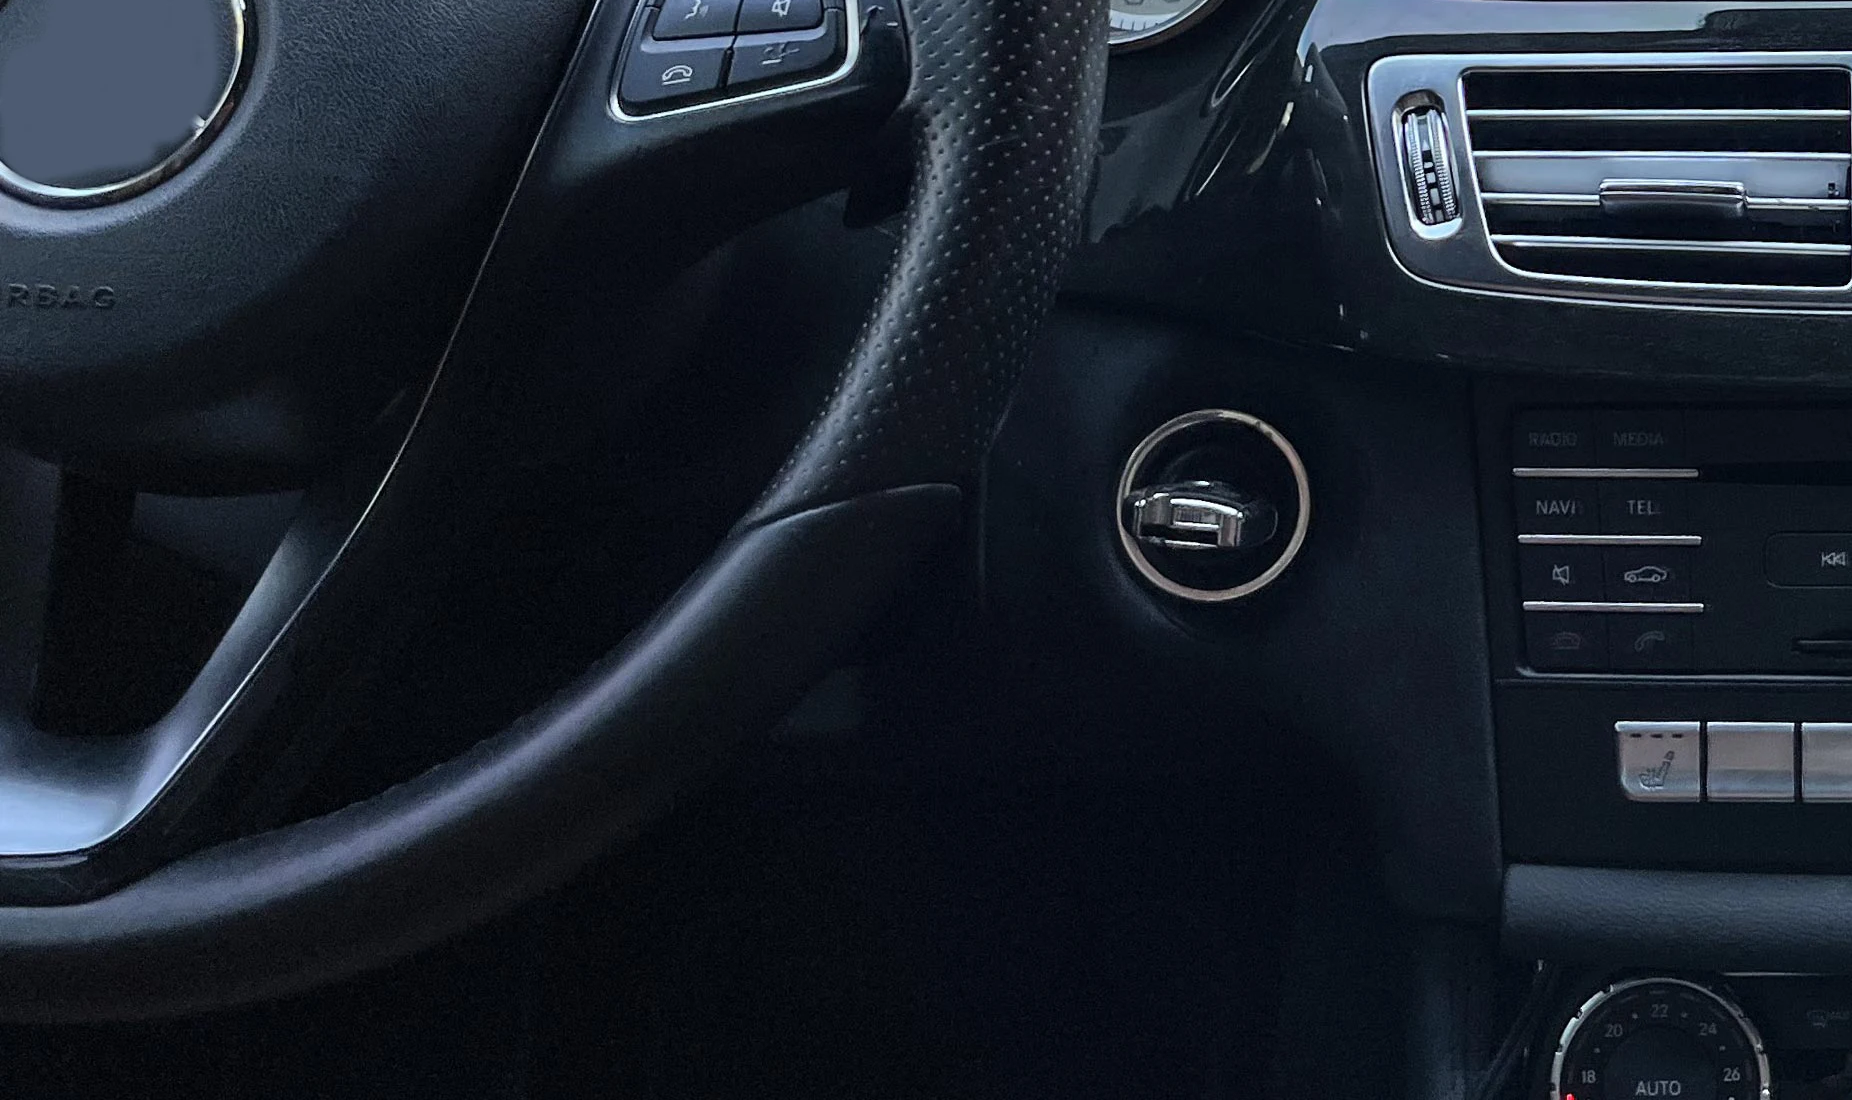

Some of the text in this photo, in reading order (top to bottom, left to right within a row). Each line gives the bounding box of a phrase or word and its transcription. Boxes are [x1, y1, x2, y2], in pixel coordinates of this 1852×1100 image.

[1535, 499, 1576, 515] NAVI
[1651, 1003, 1669, 1018] 22
[1604, 1023, 1623, 1038] 20
[1699, 1022, 1717, 1037] 24
[1582, 1068, 1597, 1084] 18
[1723, 1067, 1741, 1082] 26
[1635, 1079, 1682, 1097] AUTO
